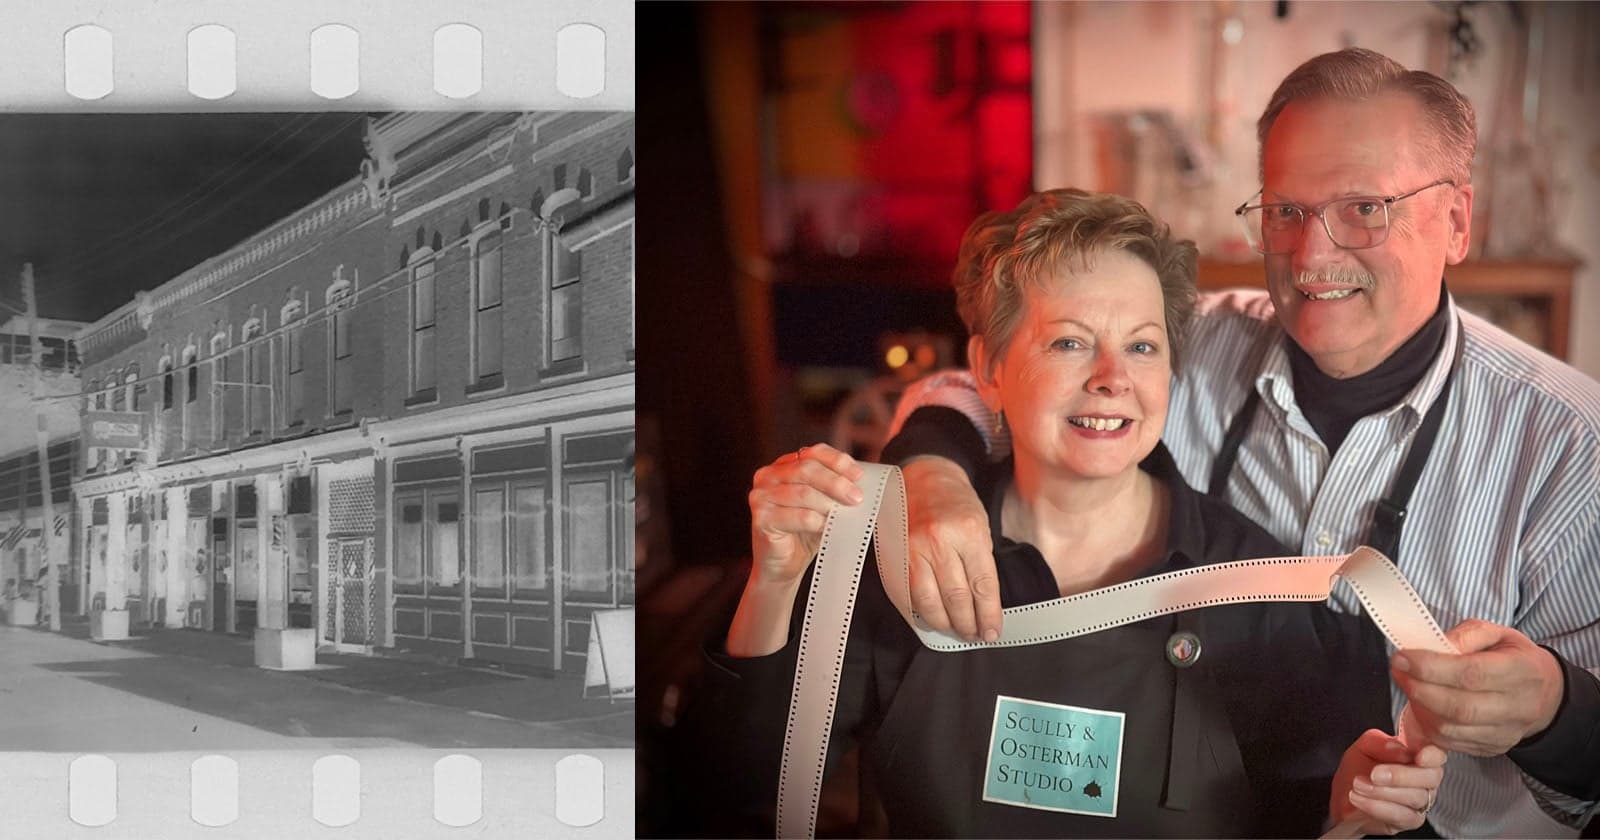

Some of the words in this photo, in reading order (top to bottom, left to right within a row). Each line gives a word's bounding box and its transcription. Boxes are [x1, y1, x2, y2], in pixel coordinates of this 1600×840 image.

[1005, 711, 1076, 738] SCULLY
[1083, 726, 1096, 742] &
[1000, 738, 1109, 769] OSTERMAN
[997, 764, 1073, 793] STUDIO
